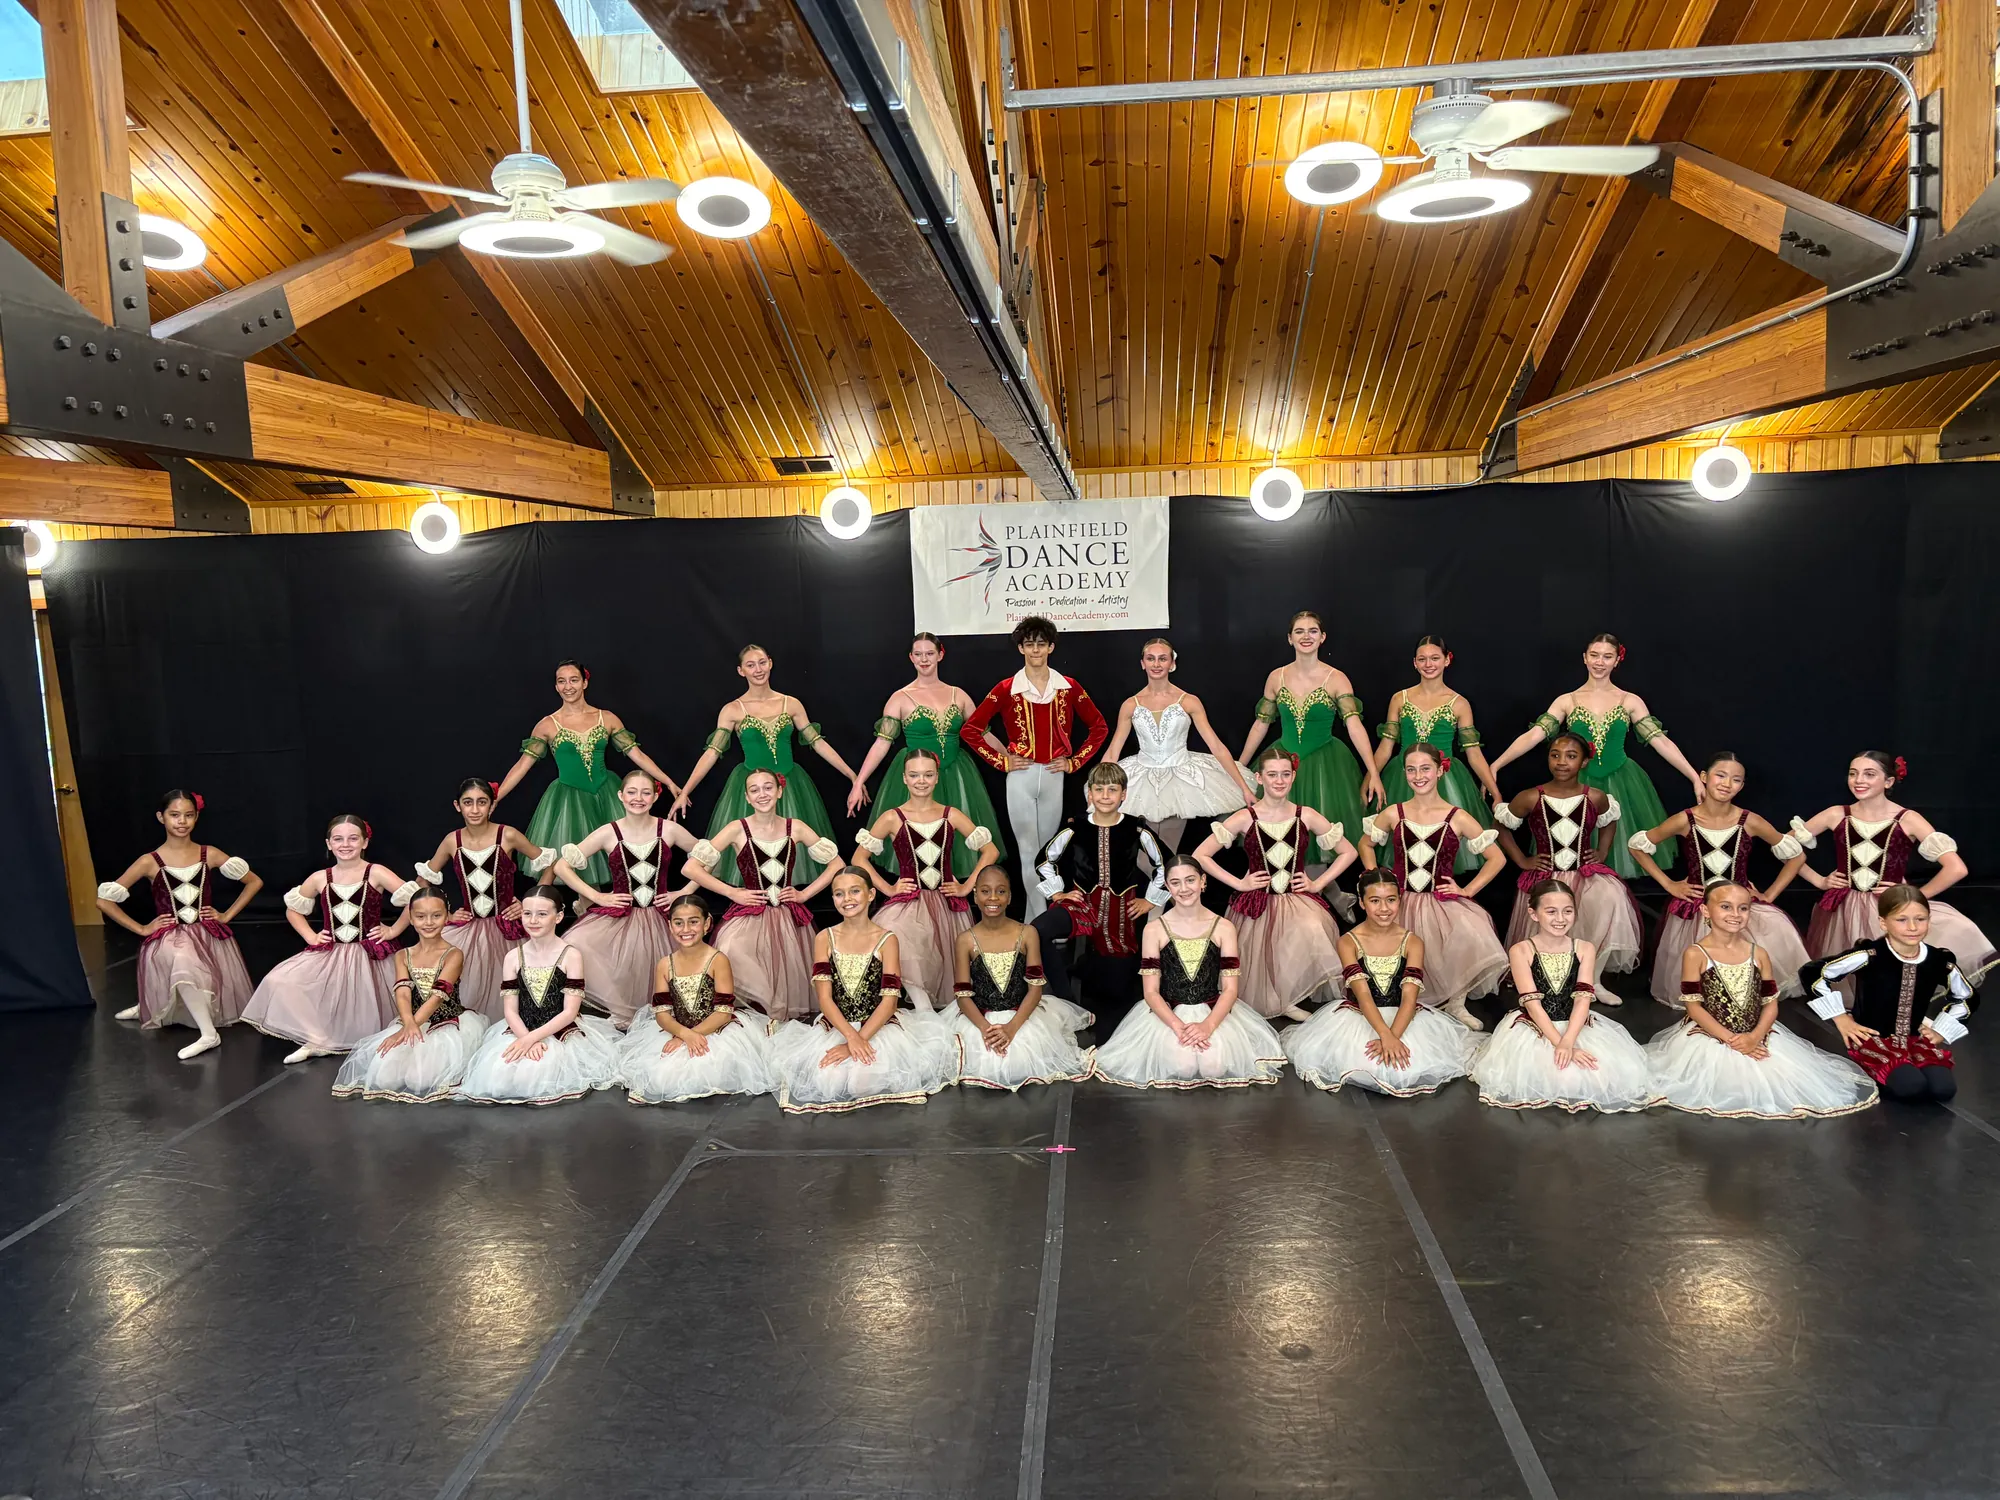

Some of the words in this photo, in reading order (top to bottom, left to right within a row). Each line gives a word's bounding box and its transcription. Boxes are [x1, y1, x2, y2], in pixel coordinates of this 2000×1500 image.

[1005, 521, 1128, 540] PLAINFIELD
[1005, 541, 1130, 569] DANCE
[1005, 570, 1130, 592] ACADEMY
[1004, 597, 1037, 607] Passion
[1048, 595, 1088, 607] Dedication
[1097, 593, 1129, 609] Artistry
